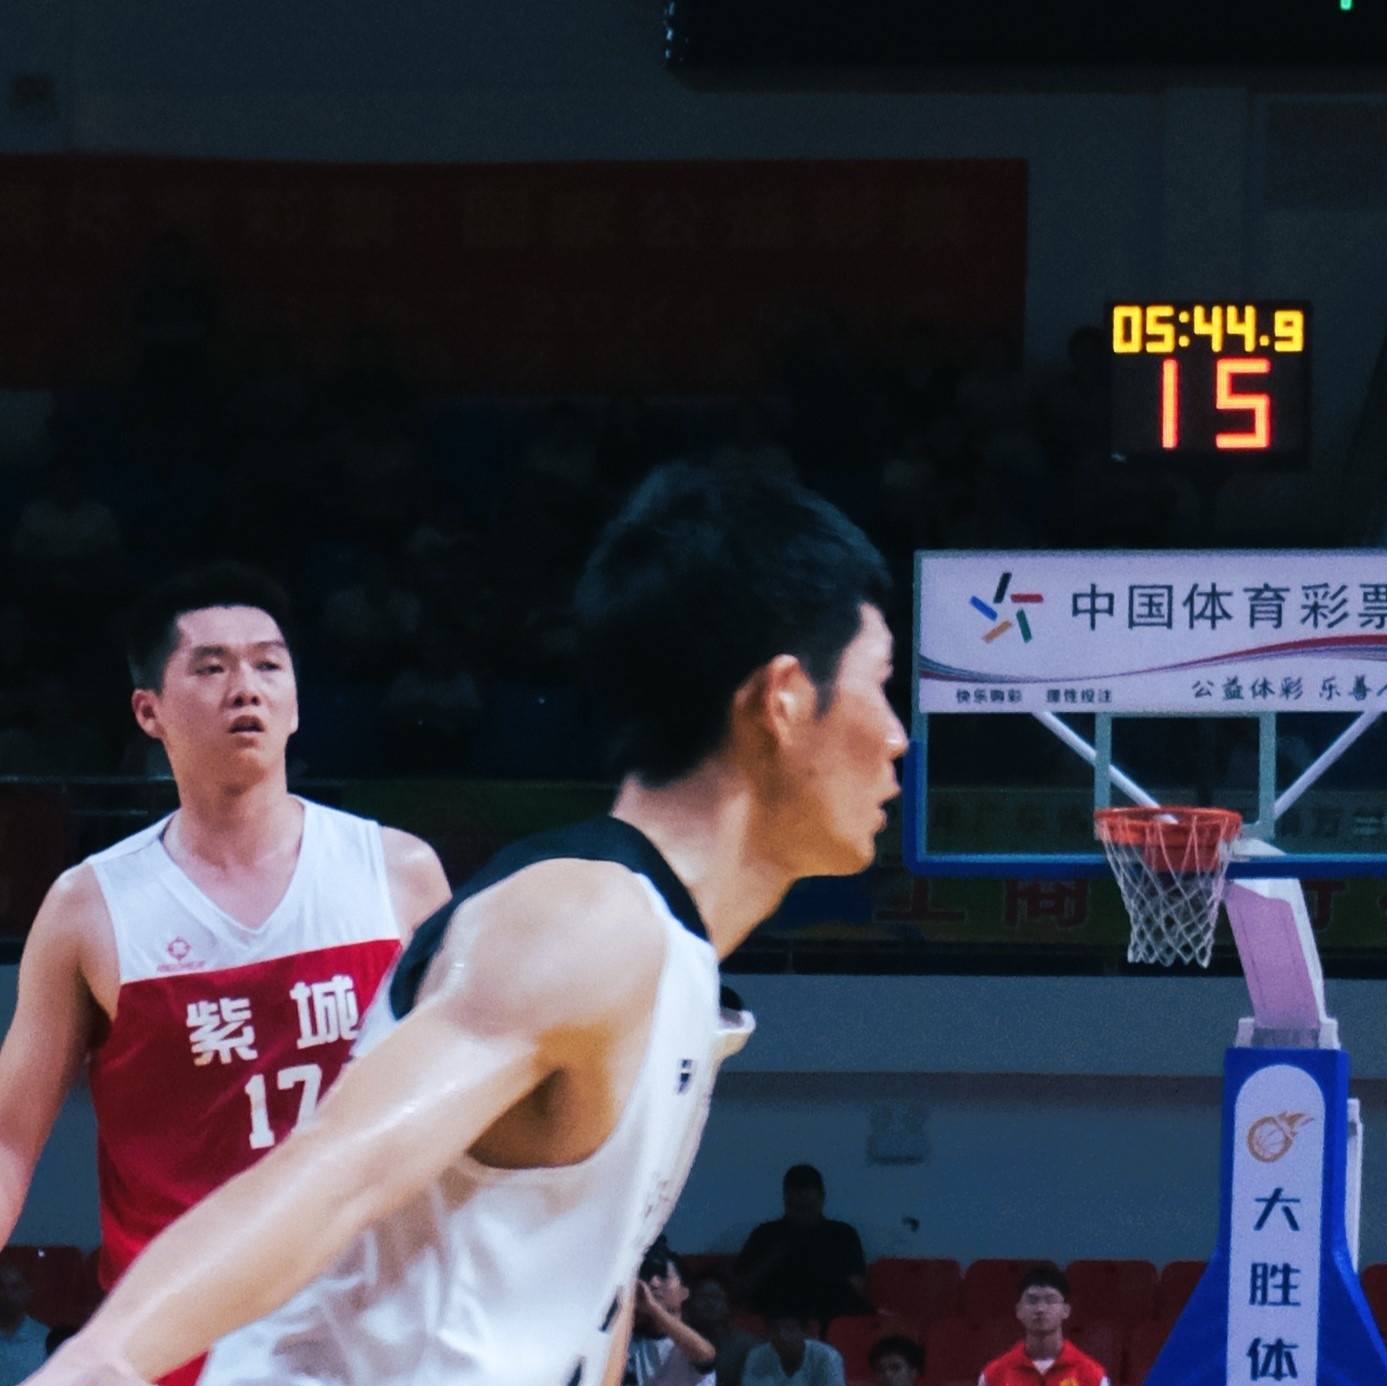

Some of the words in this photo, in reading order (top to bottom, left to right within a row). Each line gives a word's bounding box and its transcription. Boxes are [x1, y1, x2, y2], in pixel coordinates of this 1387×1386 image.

[1112, 304, 1304, 353] 05:44.9
[1161, 357, 1270, 450] 15
[186, 974, 359, 1067] 紫城
[245, 1063, 324, 1150] 17
